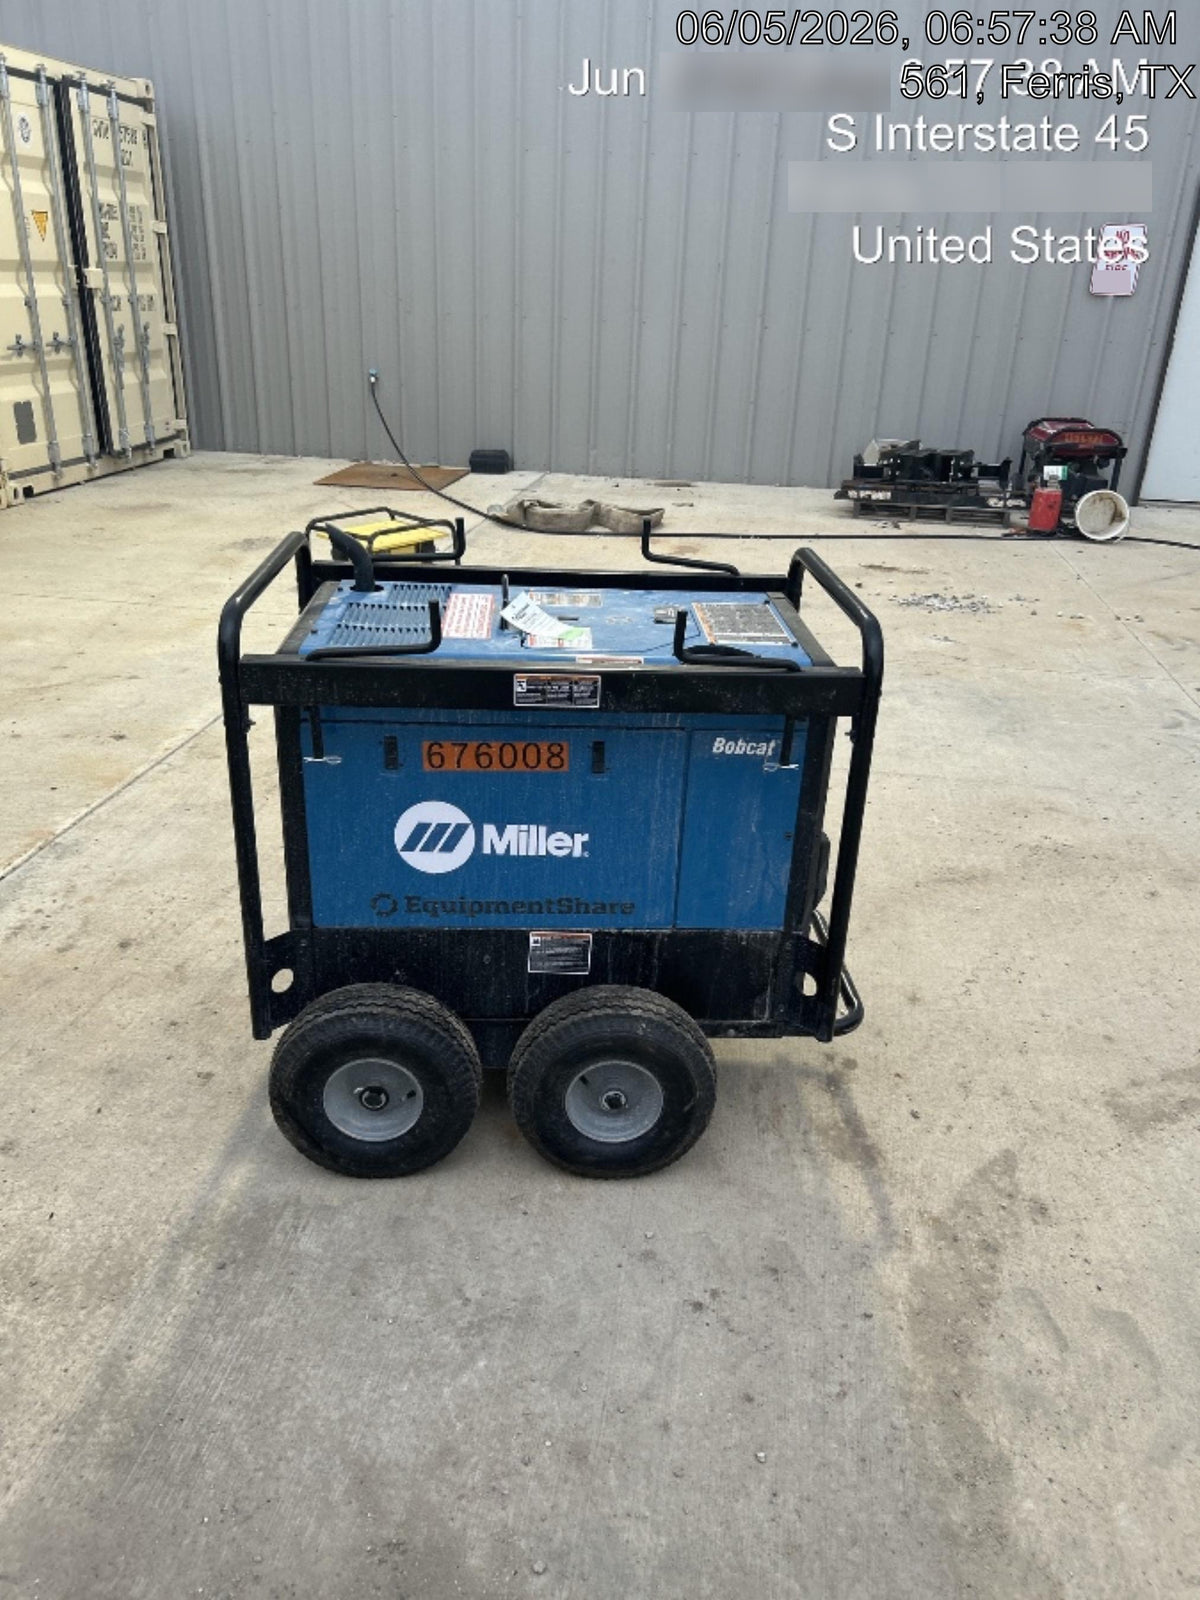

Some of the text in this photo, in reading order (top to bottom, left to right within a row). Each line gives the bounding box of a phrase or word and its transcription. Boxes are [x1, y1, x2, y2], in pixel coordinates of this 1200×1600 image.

[427, 742, 565, 769] 676008
[712, 737, 776, 756] Bobcat
[482, 823, 589, 857] Miller
[404, 896, 635, 917] EquipmentShare
